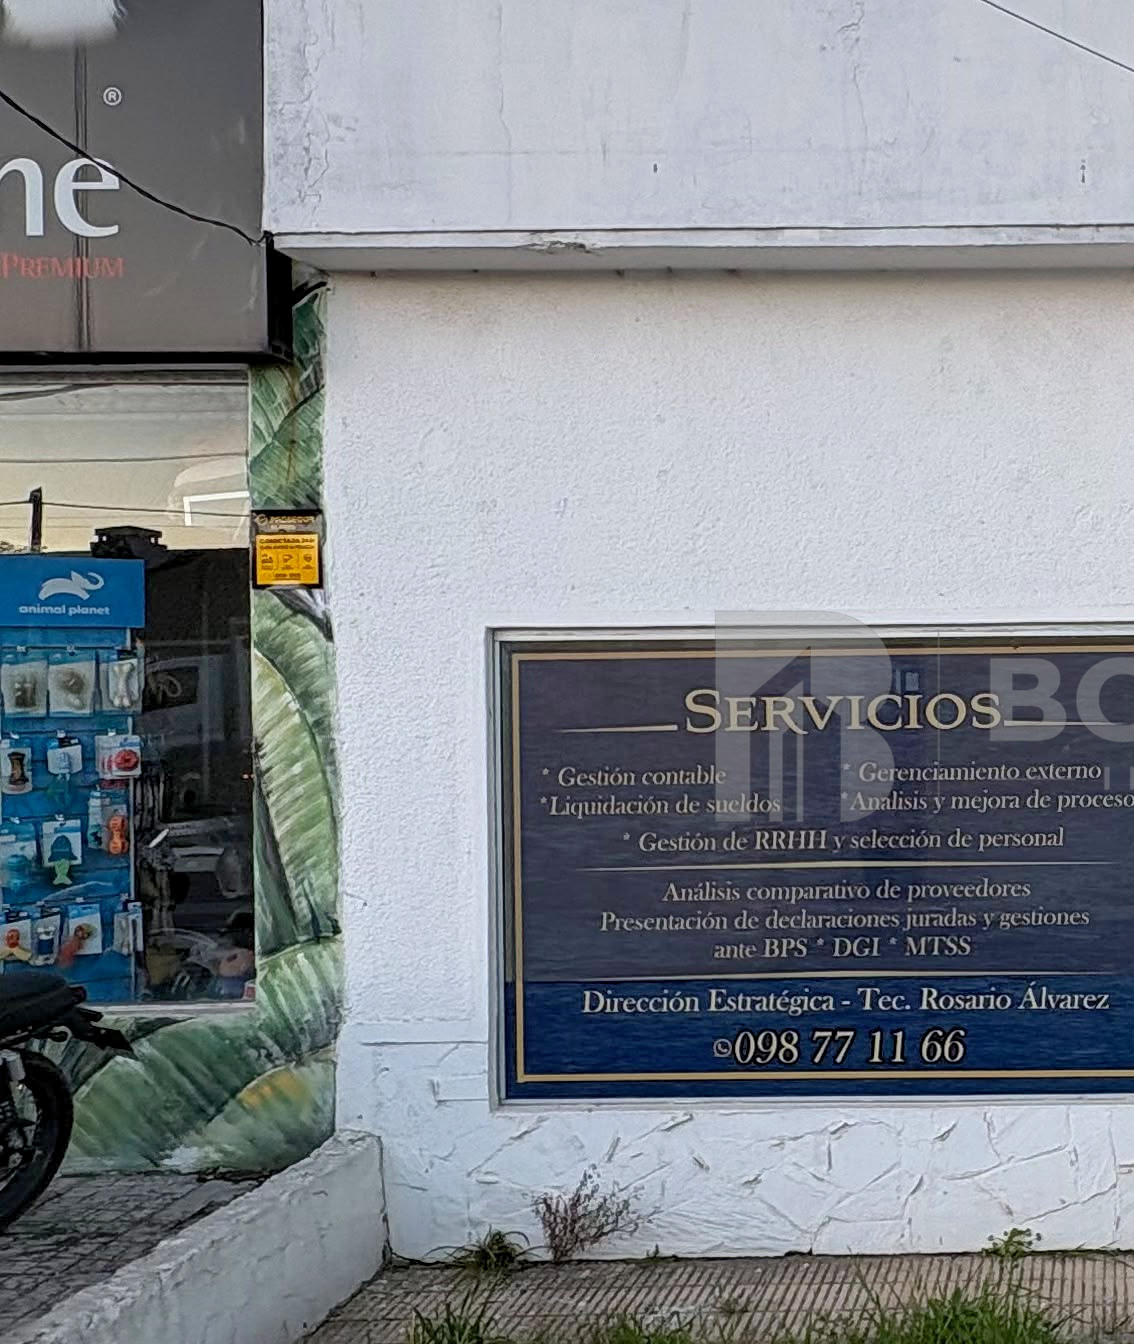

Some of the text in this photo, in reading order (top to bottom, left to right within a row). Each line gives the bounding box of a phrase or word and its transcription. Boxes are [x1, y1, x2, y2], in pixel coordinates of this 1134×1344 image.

[18, 604, 110, 616] animal planet
[684, 689, 1000, 734] SERVICIOS
[558, 765, 727, 786] Gestión contable
[859, 761, 1102, 782] Gerenciamiento externo
[675, 793, 701, 813] de
[707, 793, 781, 813] sueldos
[932, 797, 947, 814] y
[951, 789, 1020, 813] mejora
[1026, 789, 1052, 809] de
[639, 827, 1064, 853] Gestión de RRHH y selección de personal
[662, 878, 1032, 904] Análisis comparativo de proveedores
[600, 906, 1090, 932] Presentación de declaraciones juradas y gestiones
[713, 936, 972, 959] ante BPS DGI MTSS
[583, 989, 700, 1014] Dirección
[707, 987, 835, 1016] Estratégica
[856, 987, 911, 1011] Tec.
[919, 986, 1012, 1010] Rosario
[1017, 980, 1110, 1010] Álvarez
[734, 1029, 967, 1065] 098 77 11 66
